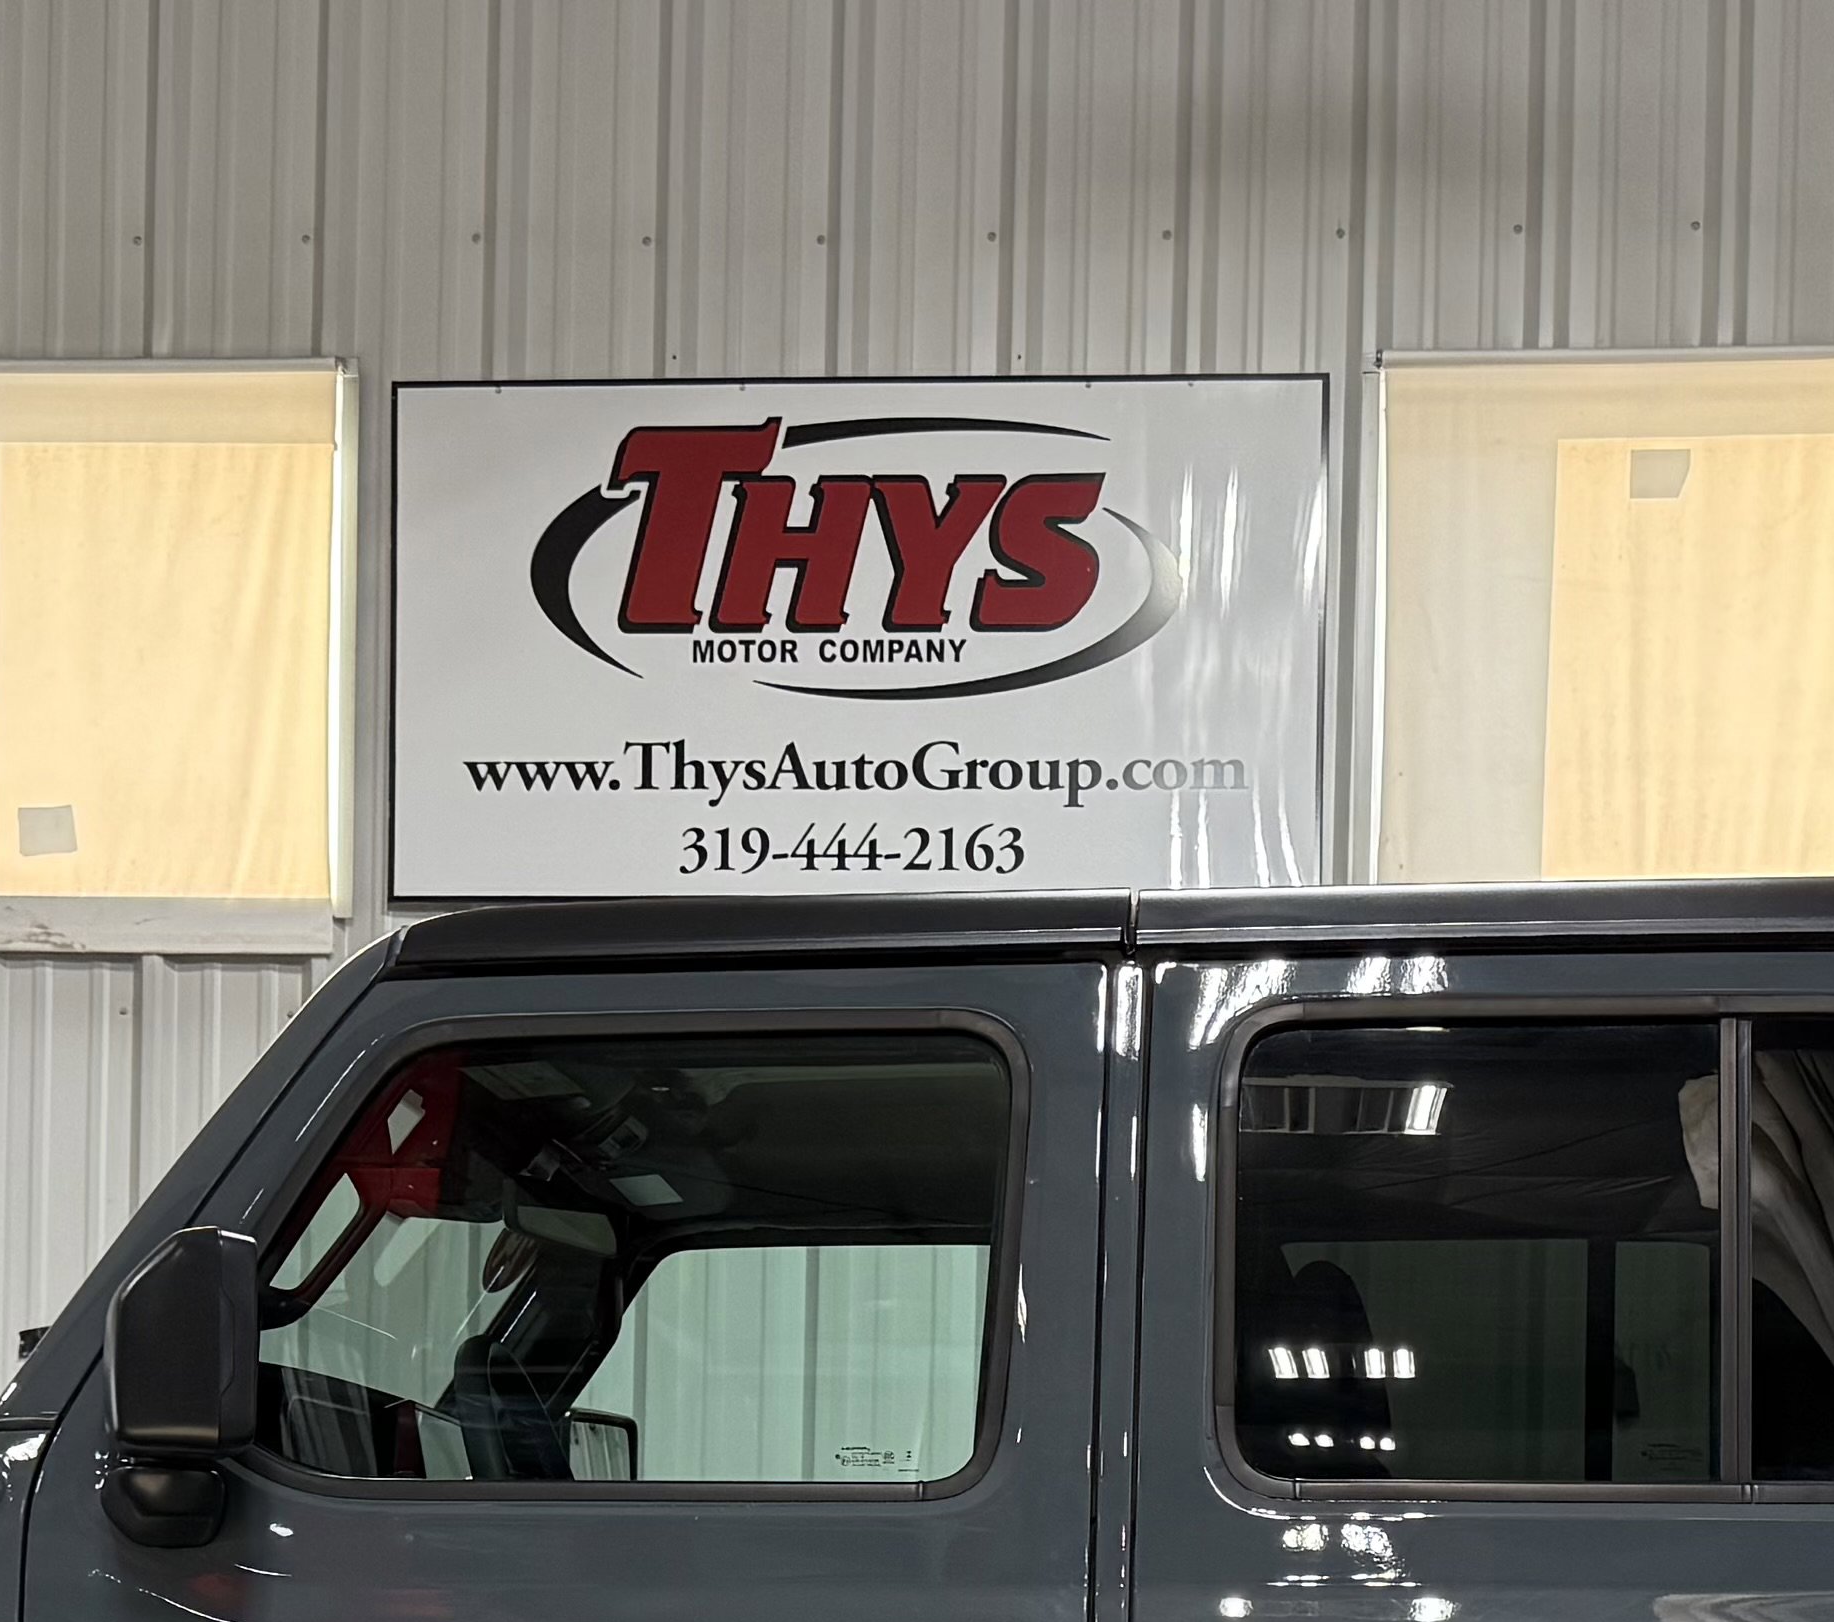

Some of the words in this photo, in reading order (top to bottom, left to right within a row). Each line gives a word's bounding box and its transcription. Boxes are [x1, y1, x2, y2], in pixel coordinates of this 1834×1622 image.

[609, 415, 1106, 634] THYS
[691, 639, 799, 665] MOTOR
[818, 638, 967, 665] COMPANY
[463, 740, 1248, 808] www.ThysAutoGroup.com
[679, 822, 1026, 876] 319-444-2163
